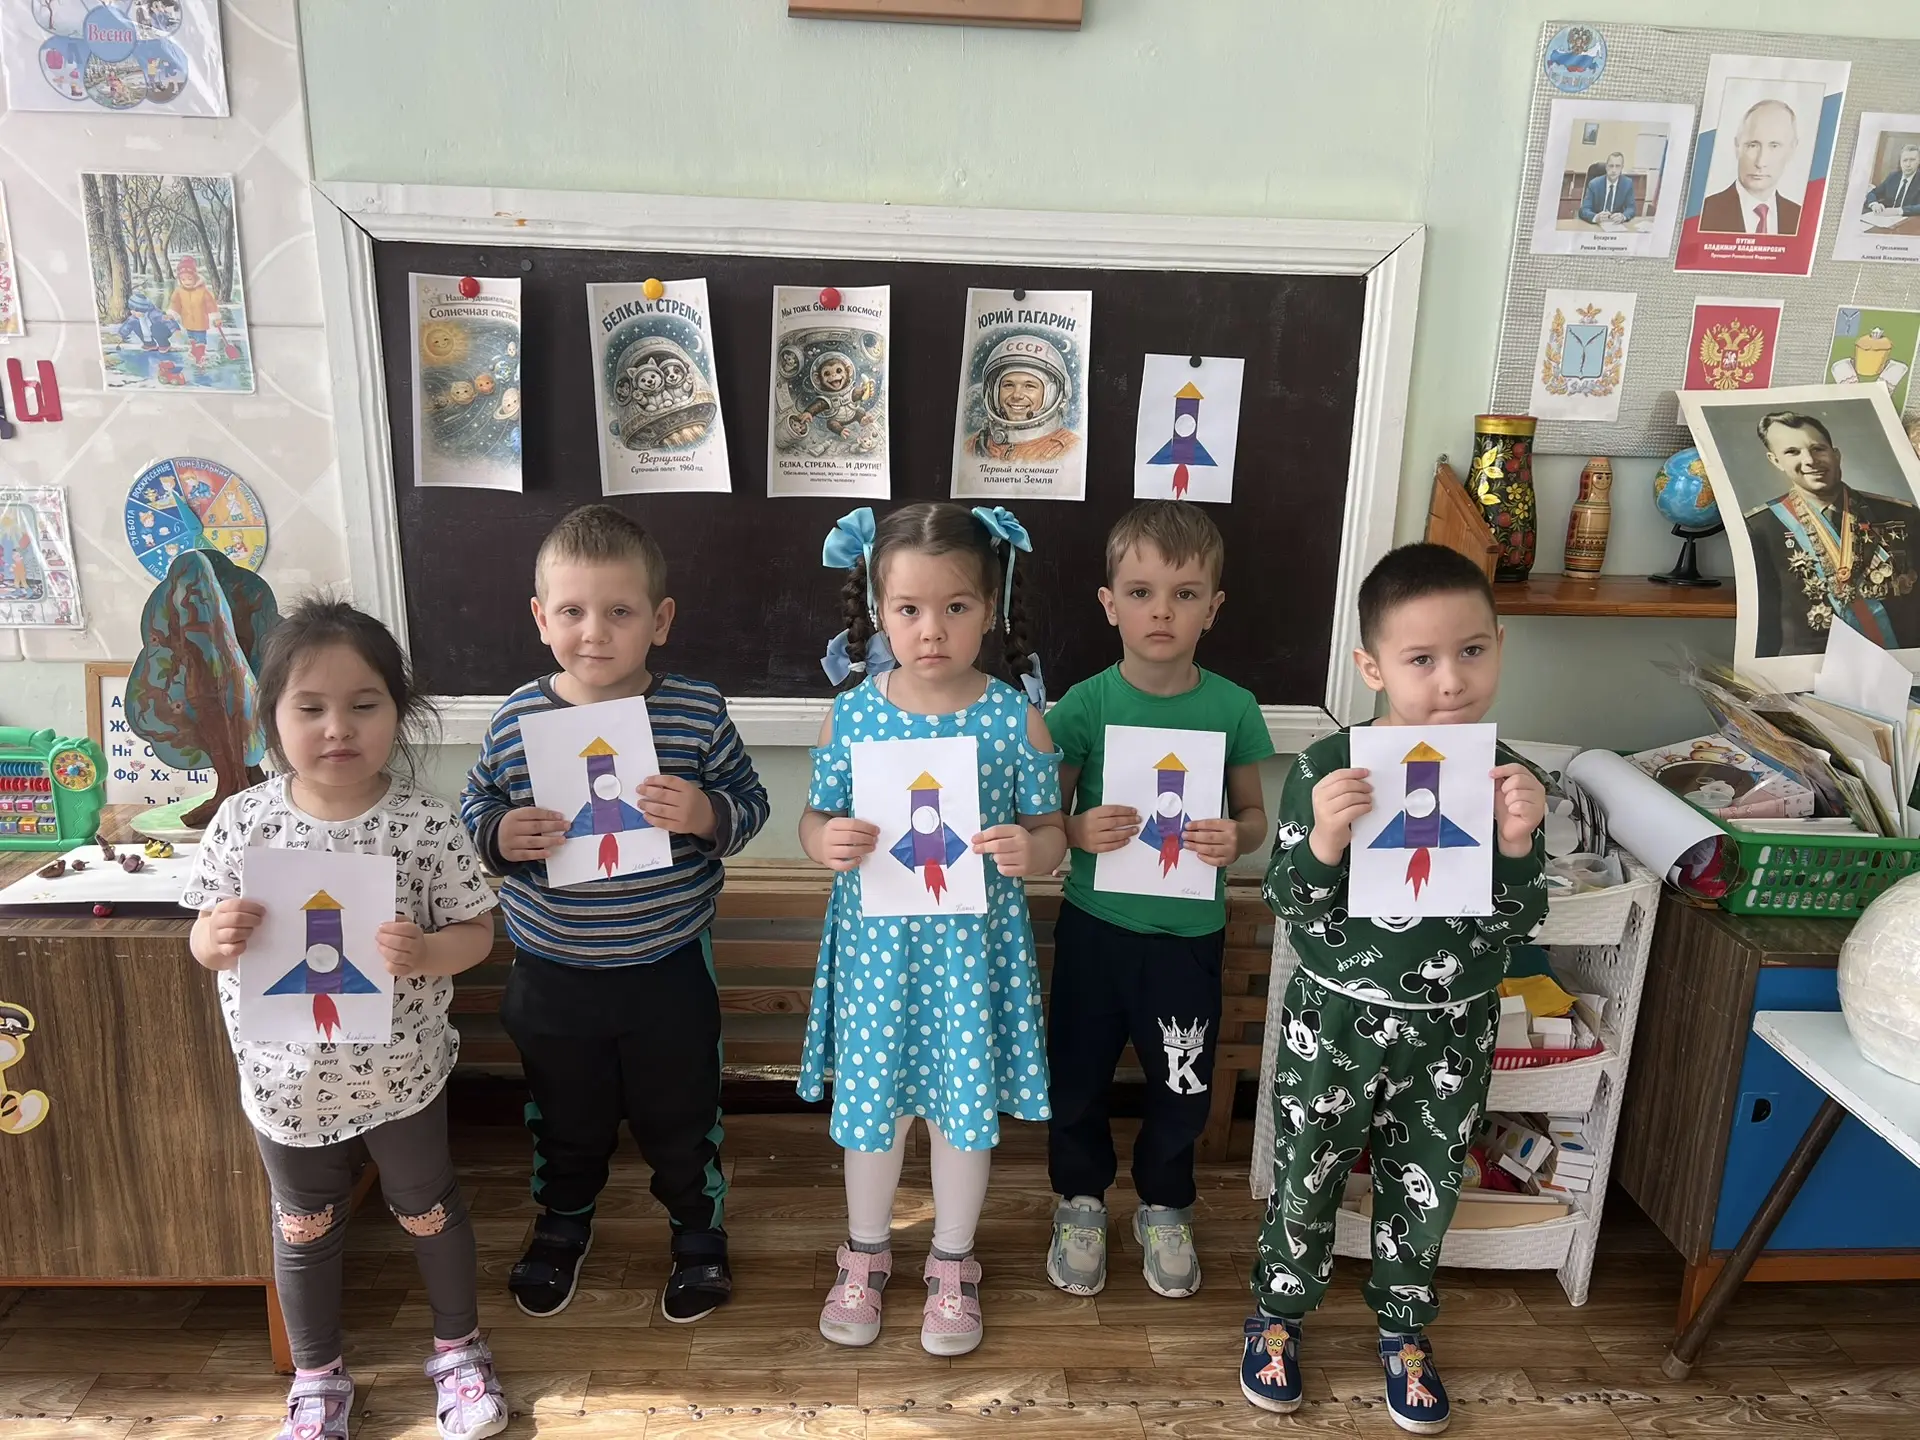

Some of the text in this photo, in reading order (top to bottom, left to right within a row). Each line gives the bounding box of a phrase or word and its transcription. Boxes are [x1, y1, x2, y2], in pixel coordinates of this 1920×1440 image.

[87, 24, 133, 43] Весна
[1703, 243, 1786, 253] ВЛАДИМИР ВЛАДИМИРОВИЧ
[429, 307, 489, 319] Солнечная
[601, 300, 646, 333] БЕЛКА
[655, 298, 703, 329] СТРЕЛКА
[781, 307, 793, 319] Мы
[978, 307, 1077, 332] ЮРИЙ ГАГАРИН
[1006, 342, 1043, 354] СССР
[637, 451, 696, 466] Вернулись!
[679, 464, 695, 472] 1960
[979, 463, 1060, 475] Первый космонавт
[131, 462, 172, 500] ВОСКРЕСЕНЬЕ
[983, 474, 1053, 484] планеты Земля
[127, 508, 140, 547] СУББОТА
[173, 521, 181, 534] 6
[112, 744, 132, 757] Нн
[113, 768, 209, 784] Фф Хх Цц
[41, 803, 48, 811] 6
[42, 825, 55, 833] 13
[1163, 1045, 1208, 1095] K
